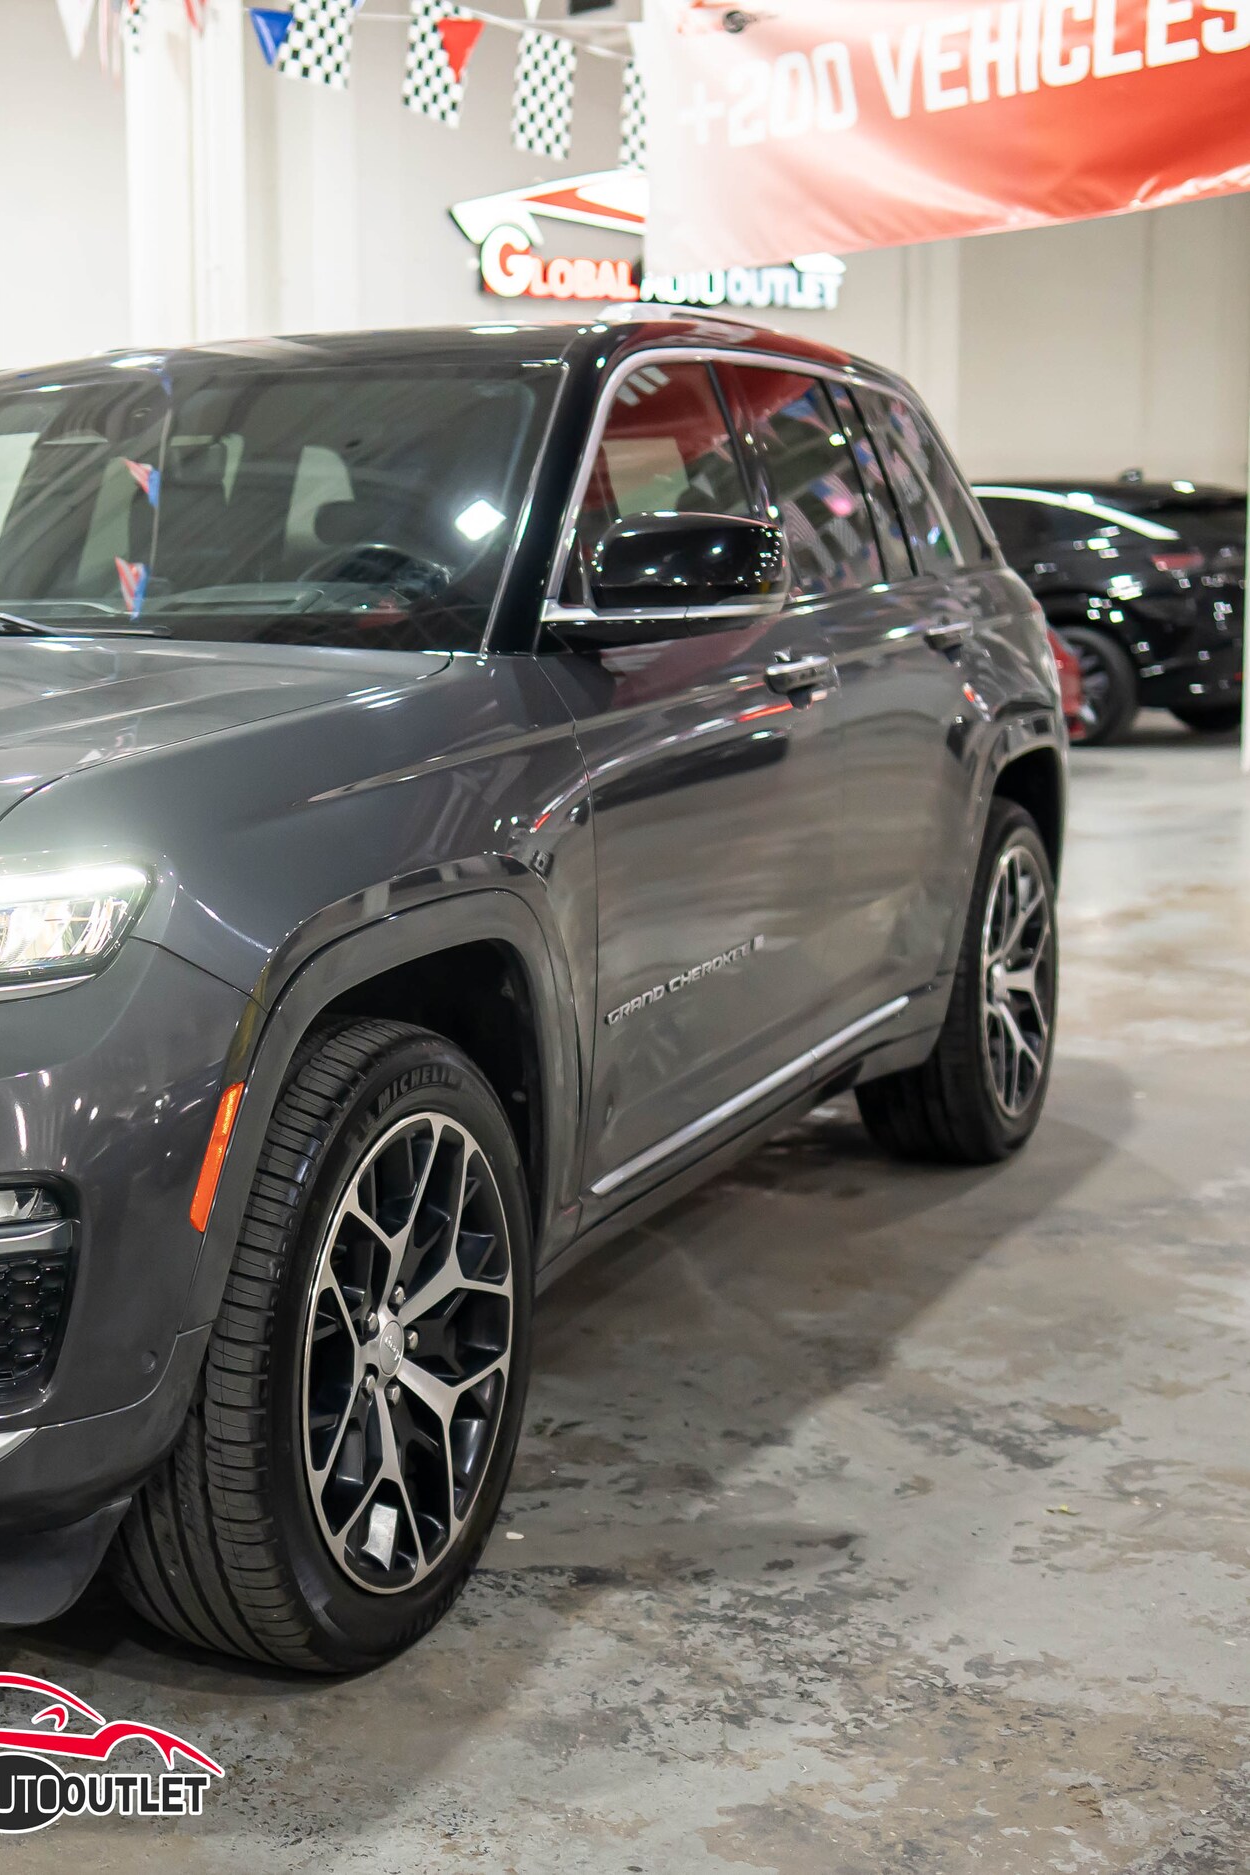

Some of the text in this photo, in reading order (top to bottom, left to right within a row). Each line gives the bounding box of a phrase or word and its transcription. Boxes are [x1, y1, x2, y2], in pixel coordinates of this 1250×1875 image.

[678, 0, 1250, 146] +200 VEHICLES
[481, 225, 641, 299] GLOBAL
[606, 984, 665, 1026] GRAND
